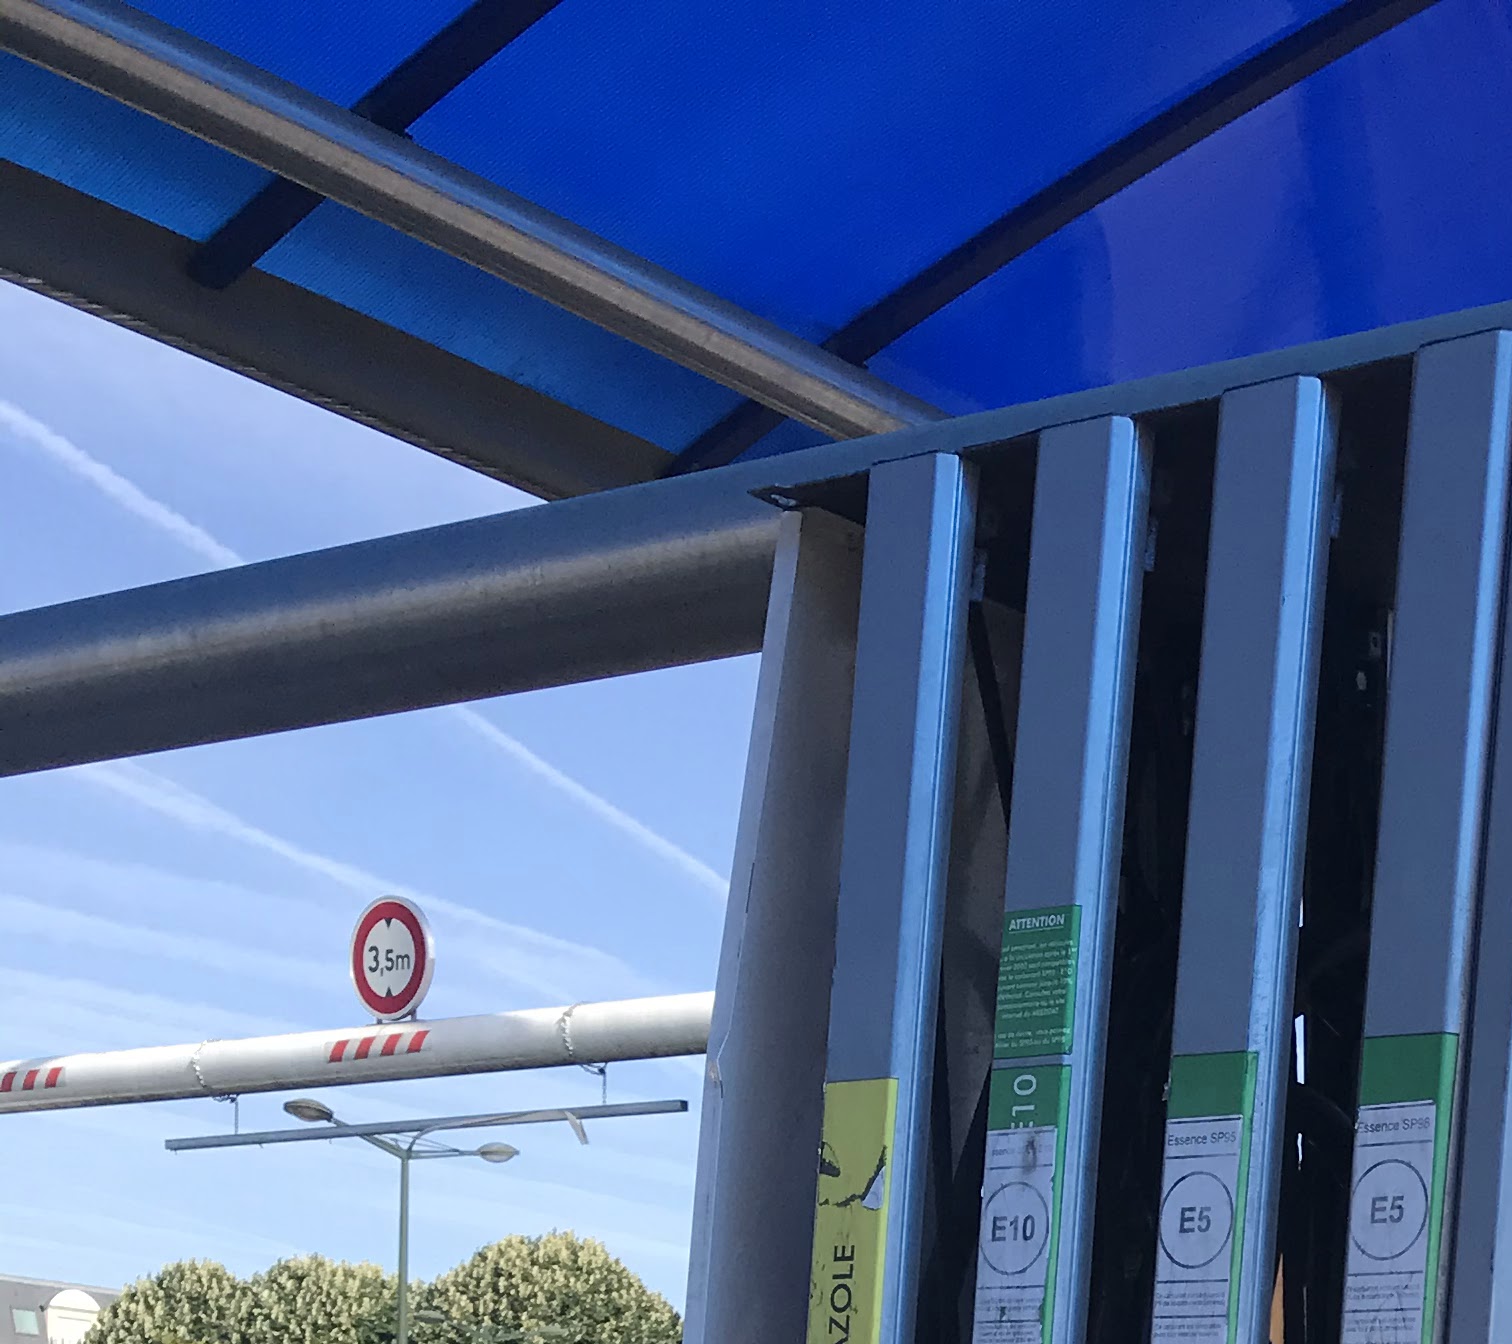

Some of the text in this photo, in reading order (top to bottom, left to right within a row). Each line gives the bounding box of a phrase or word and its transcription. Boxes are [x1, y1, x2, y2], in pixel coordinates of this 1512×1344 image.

[1008, 914, 1065, 931] ATTENTION
[368, 945, 410, 977] 3,5m
[1011, 1074, 1037, 1129] 10
[1167, 1133, 1208, 1147] Essence
[1357, 1121, 1400, 1134] Essence
[1179, 1206, 1211, 1233] E5
[1370, 1195, 1404, 1224] E5
[991, 1214, 1036, 1242] E10
